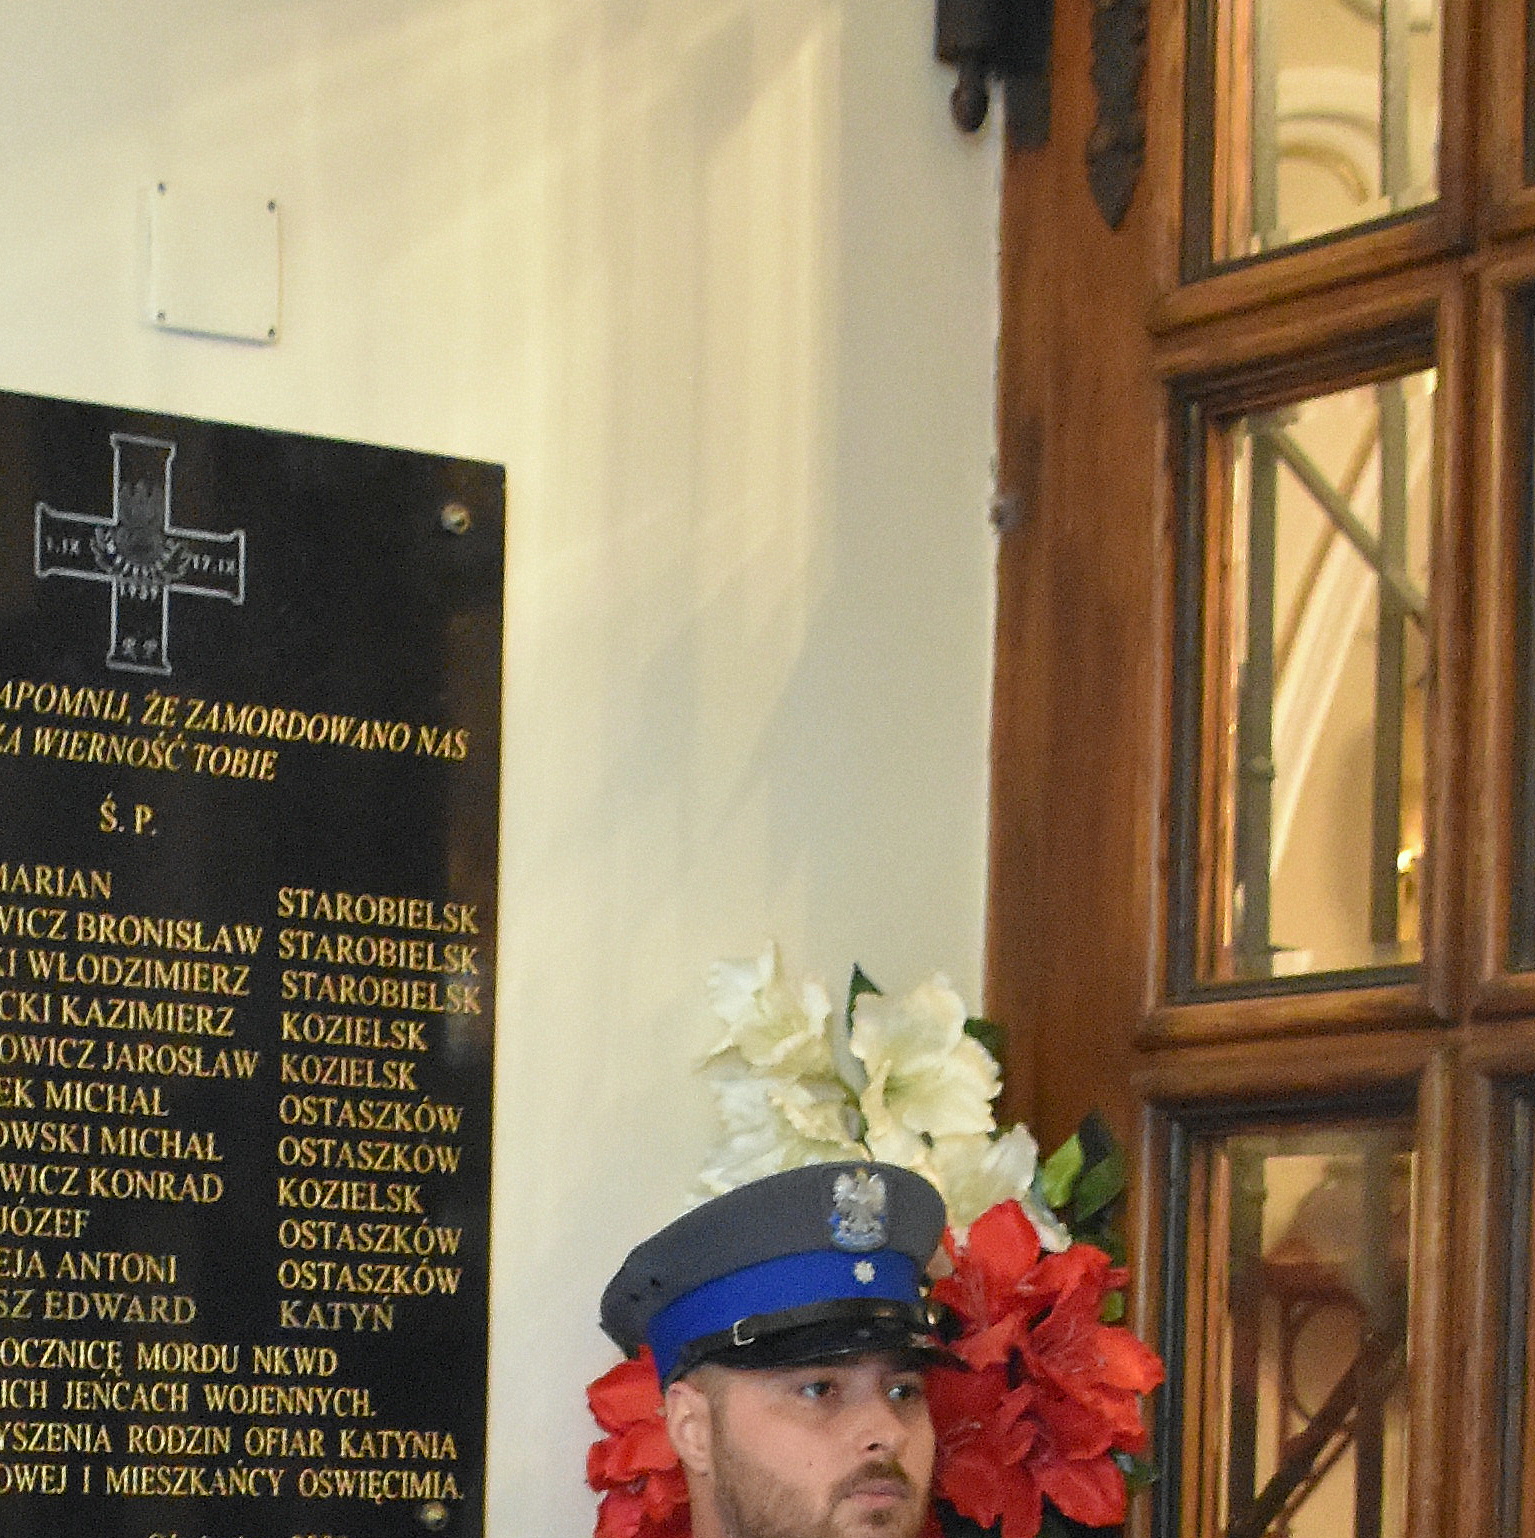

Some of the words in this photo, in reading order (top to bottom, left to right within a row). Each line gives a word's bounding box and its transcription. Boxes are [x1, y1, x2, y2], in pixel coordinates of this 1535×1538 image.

[185, 698, 411, 752] ZAMORDOWANO
[415, 724, 470, 761] NAS
[33, 725, 188, 772] WIERNOŚĆ
[193, 743, 279, 781] TOBIE
[277, 886, 480, 934] STAROBIELSK
[278, 928, 479, 975] STAROBIELSK
[281, 969, 482, 1016] STAROBIELSK
[63, 995, 235, 1037] KAZIMIERZ
[281, 1011, 428, 1051] KOZIELSK
[280, 1053, 417, 1090] KOZIELSK
[278, 1094, 463, 1133] OSTASZKÓW
[89, 1166, 224, 1203] KONRAD
[277, 1177, 424, 1213] KOZIELSK
[278, 1217, 462, 1255] OSTASZKÓW
[57, 1251, 177, 1284] ANTONI
[278, 1258, 462, 1294] OSTASZKÓW
[44, 1289, 197, 1325] EDWARD
[279, 1296, 395, 1331] KATYŃ
[137, 1341, 240, 1374] MORDU
[252, 1345, 338, 1377] NKWD
[204, 1383, 376, 1417] WOJENNYCH.
[128, 1424, 231, 1455] RODZIN
[245, 1427, 325, 1457] OFIAR
[340, 1428, 458, 1460] KATYNIA
[83, 1465, 91, 1494] I
[105, 1459, 285, 1497] MIESZKAŃCY
